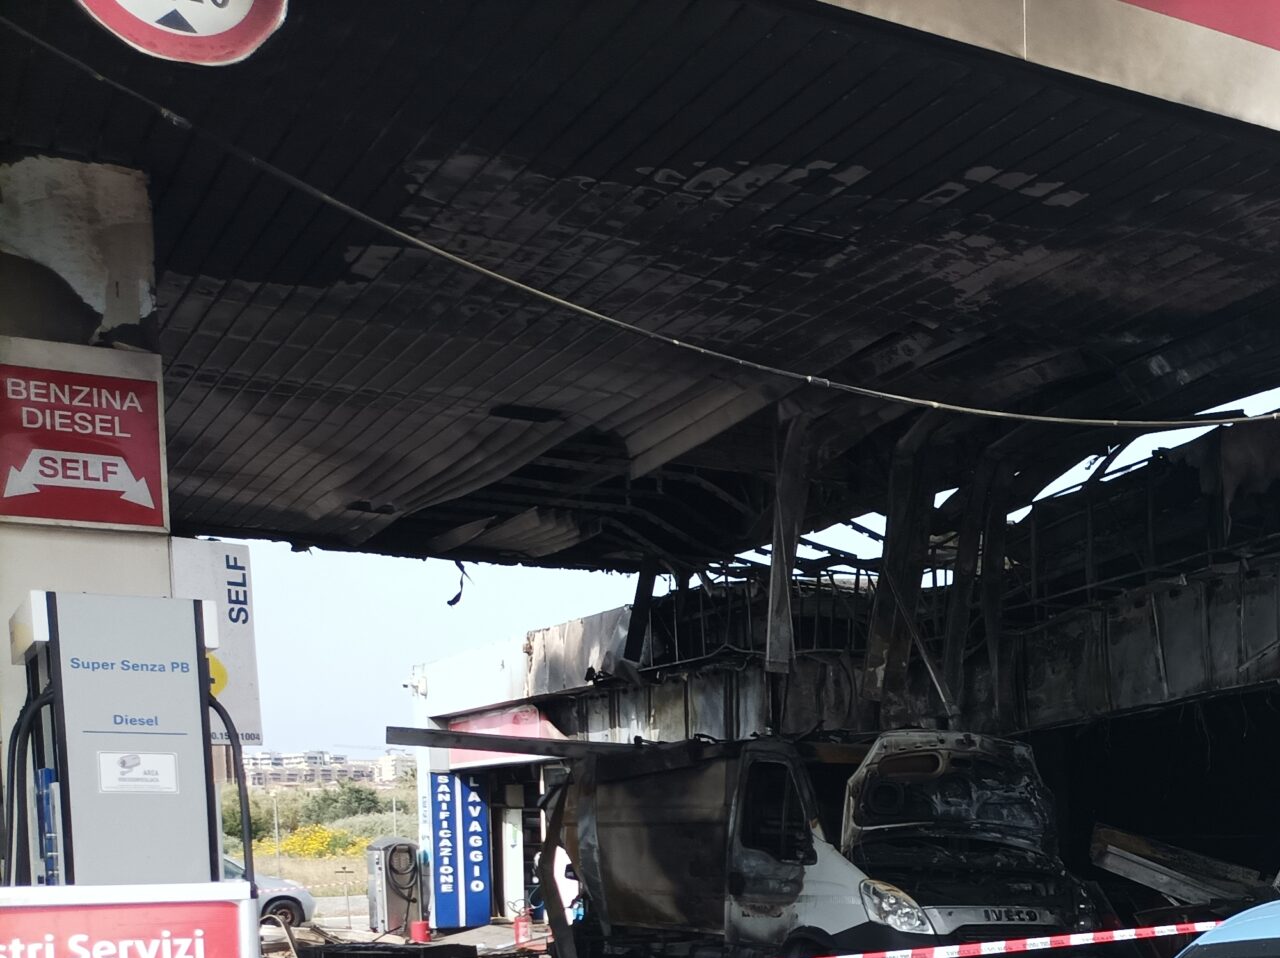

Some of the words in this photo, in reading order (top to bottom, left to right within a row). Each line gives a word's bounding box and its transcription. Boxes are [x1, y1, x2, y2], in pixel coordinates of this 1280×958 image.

[6, 378, 143, 412] BENZINA
[22, 406, 132, 438] DIESEL
[38, 455, 119, 483] SELF
[225, 554, 250, 625] SELF
[70, 657, 115, 673] Super
[121, 659, 166, 673] Senza
[171, 661, 190, 673] PB
[113, 714, 159, 727] Diesel
[436, 775, 455, 893] SANIFICAZIONE
[467, 776, 485, 893] LAVAGGIO
[984, 908, 1038, 923] IVECO
